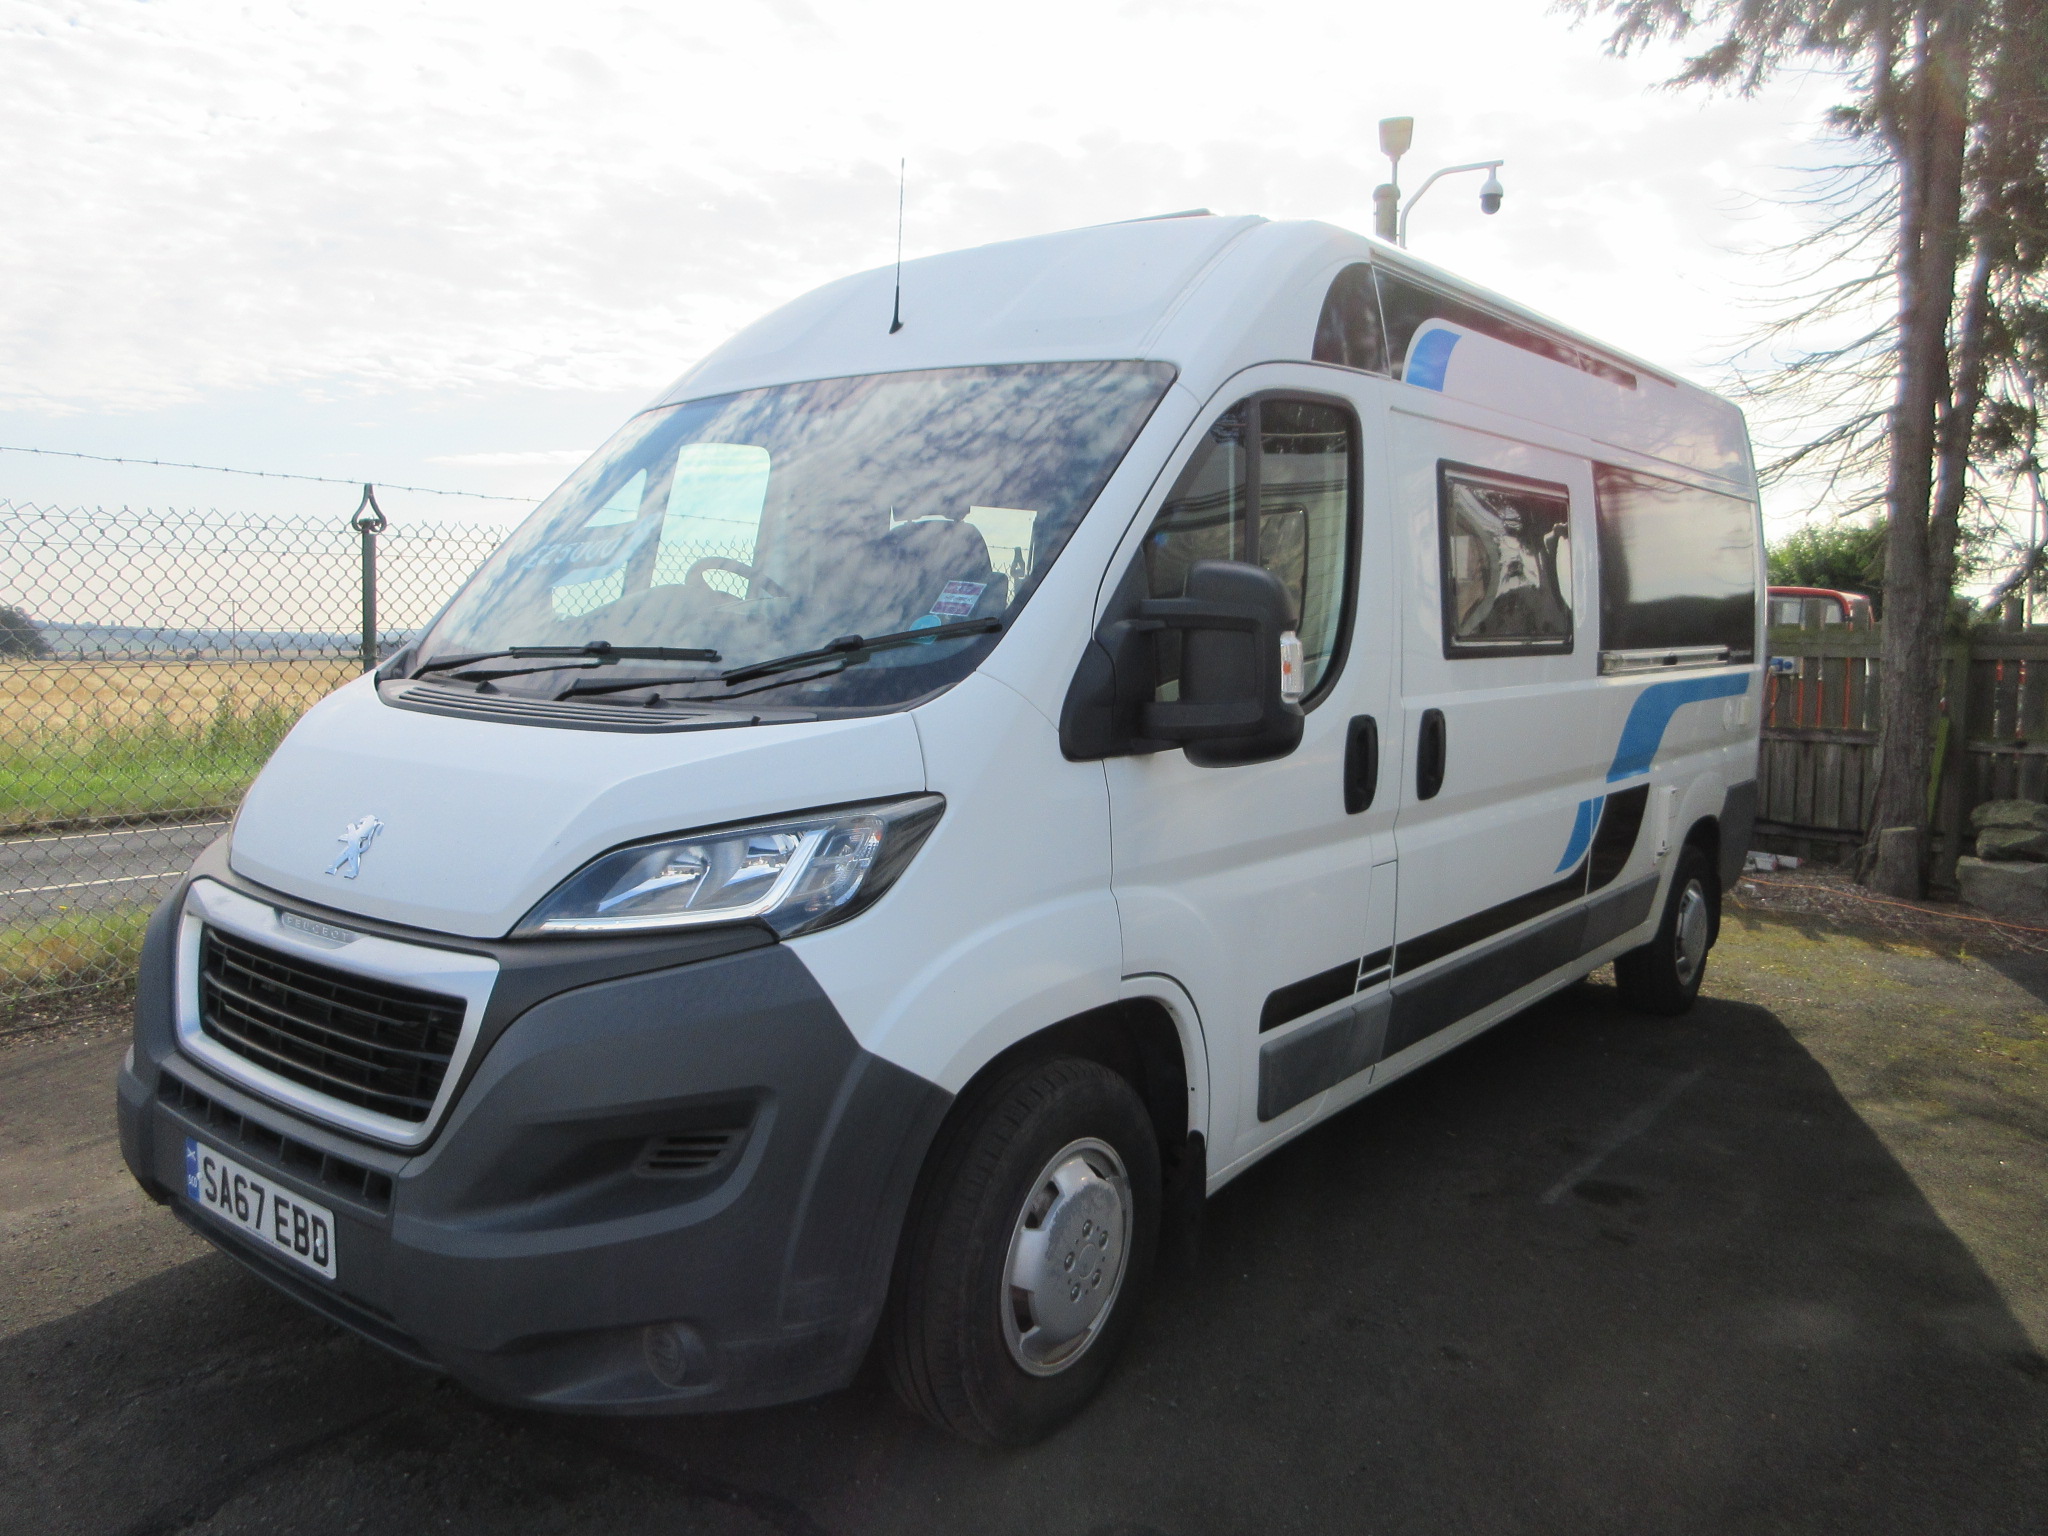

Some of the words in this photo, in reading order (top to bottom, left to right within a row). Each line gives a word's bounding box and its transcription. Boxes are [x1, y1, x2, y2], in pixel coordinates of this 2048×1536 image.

[286, 916, 349, 941] PEUGEOT
[203, 1156, 265, 1230] SA67
[273, 1194, 329, 1268] EBD
